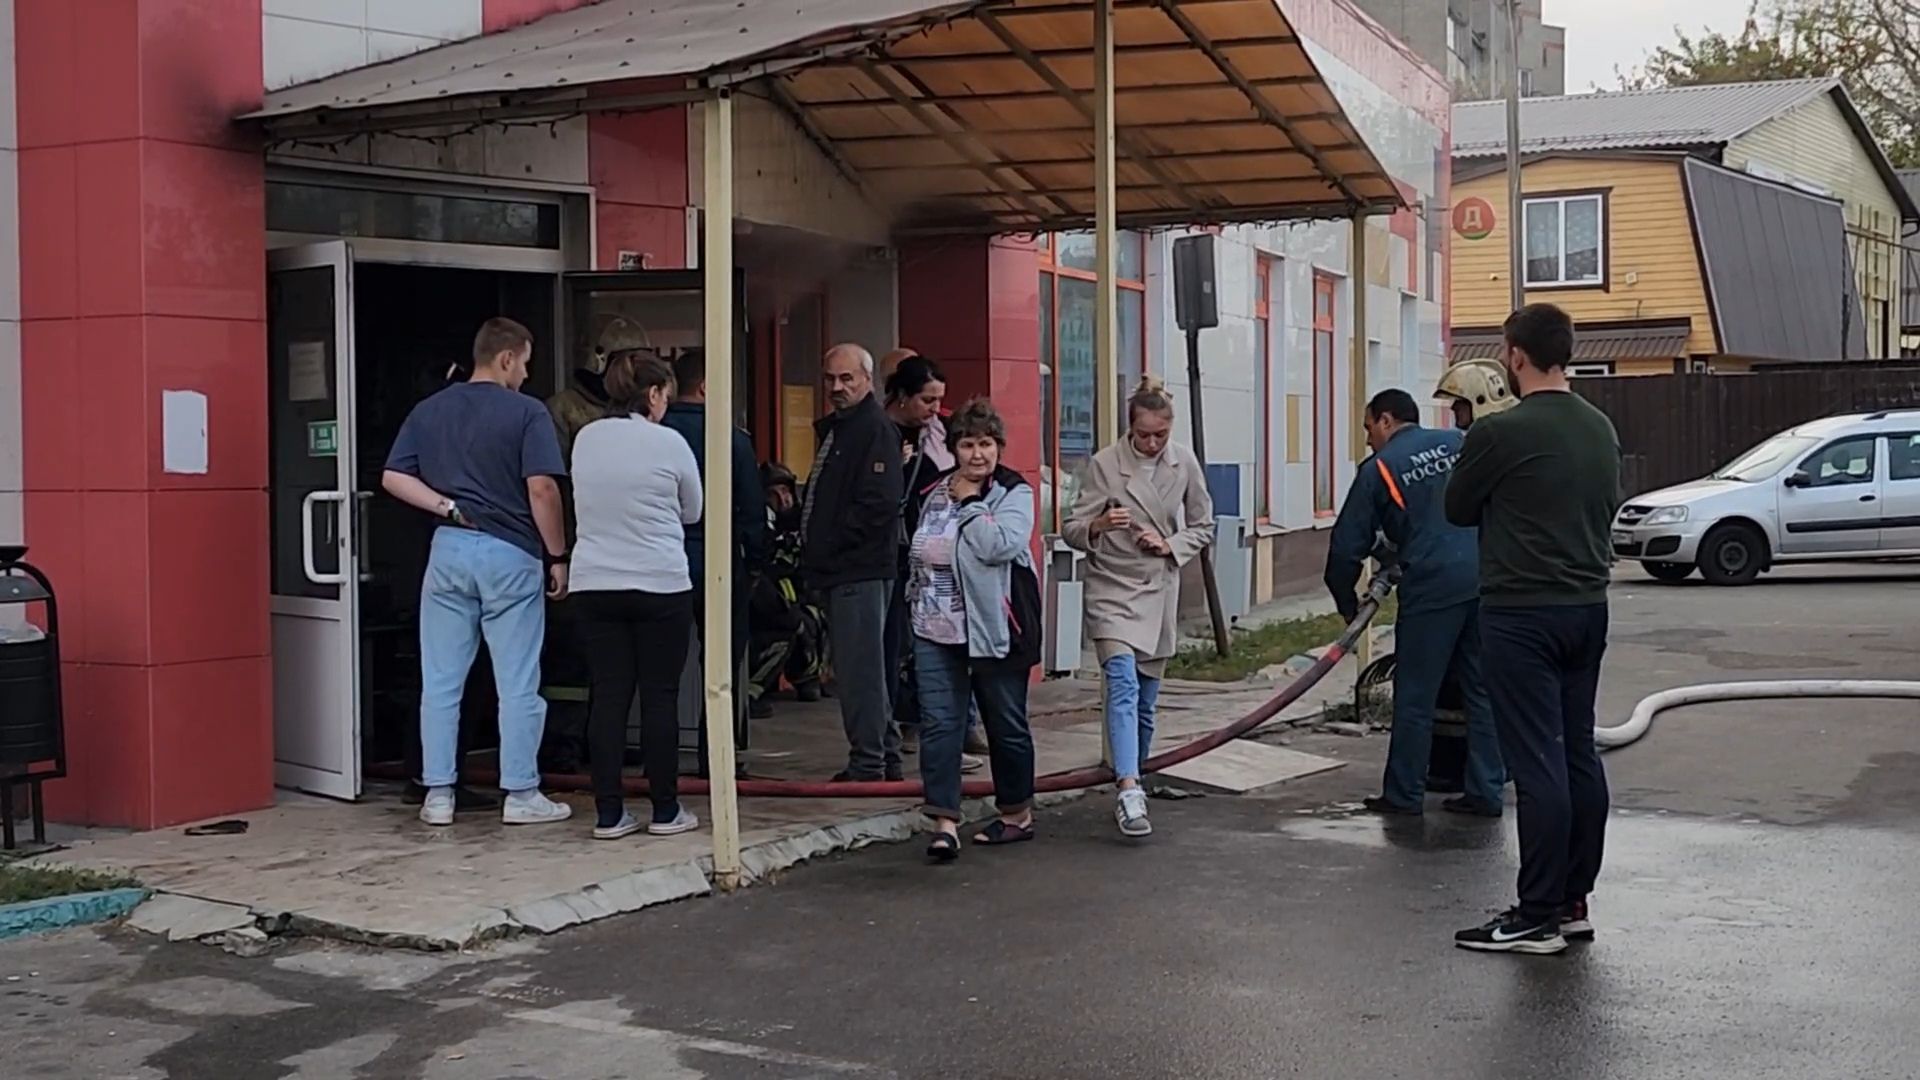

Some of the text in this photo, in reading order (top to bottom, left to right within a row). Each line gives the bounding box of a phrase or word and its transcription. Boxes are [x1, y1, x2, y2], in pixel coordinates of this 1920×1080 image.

[1462, 206, 1483, 230] Д
[1409, 444, 1449, 466] МЧС
[1401, 453, 1461, 486] РОССИ
